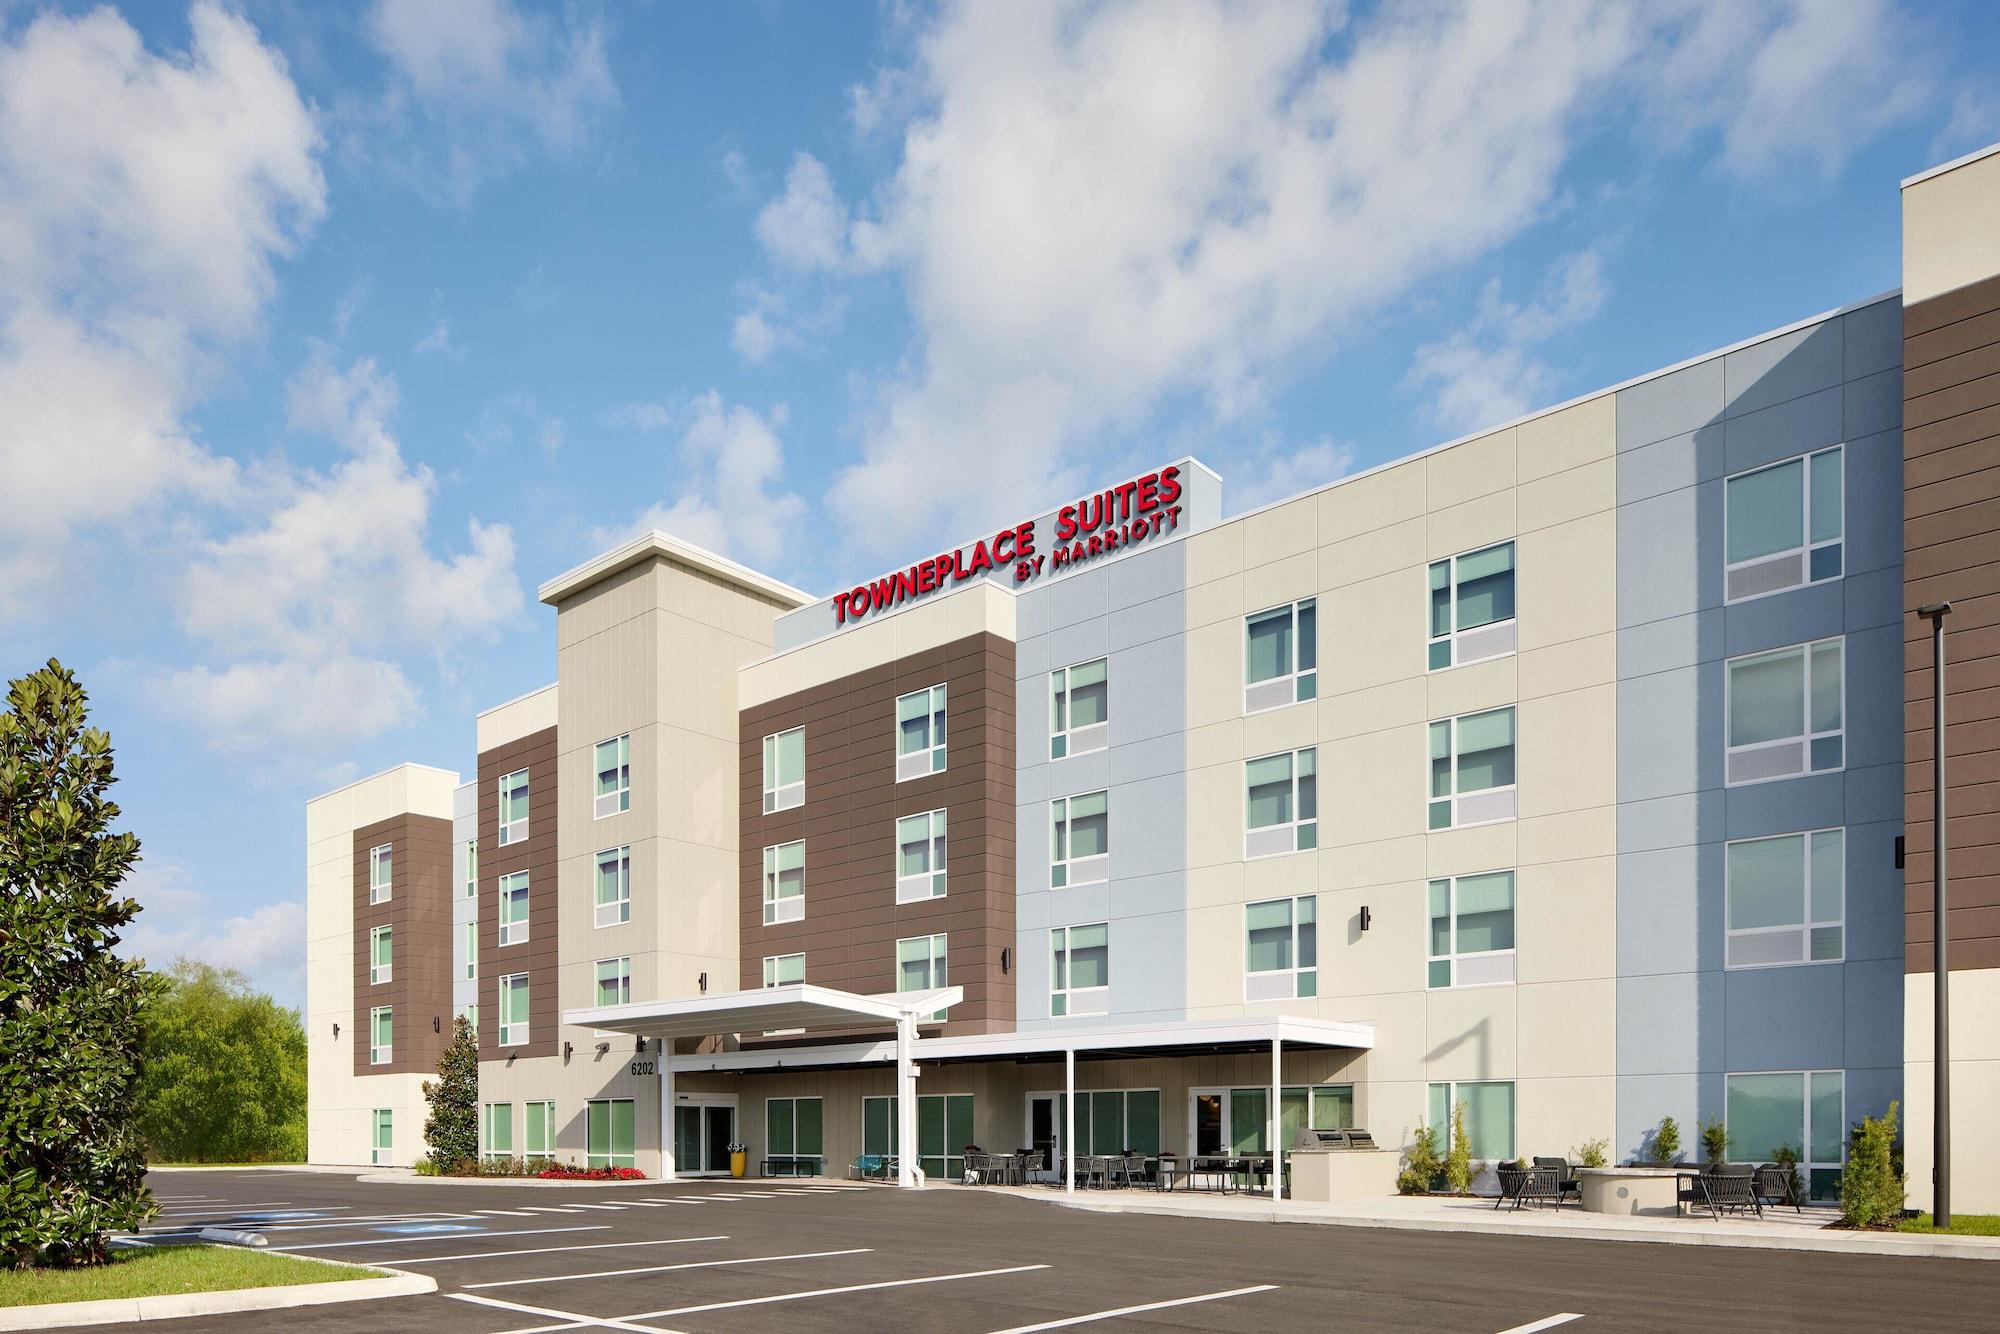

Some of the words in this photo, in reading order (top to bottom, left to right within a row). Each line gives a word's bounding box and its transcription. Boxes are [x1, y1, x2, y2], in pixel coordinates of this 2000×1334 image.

[833, 521, 1035, 623] TOWNEPLACE
[1057, 466, 1182, 540] SUITES
[1015, 555, 1045, 582] BY
[1052, 505, 1182, 569] MARRIOTT
[631, 1062, 654, 1076] 6202
